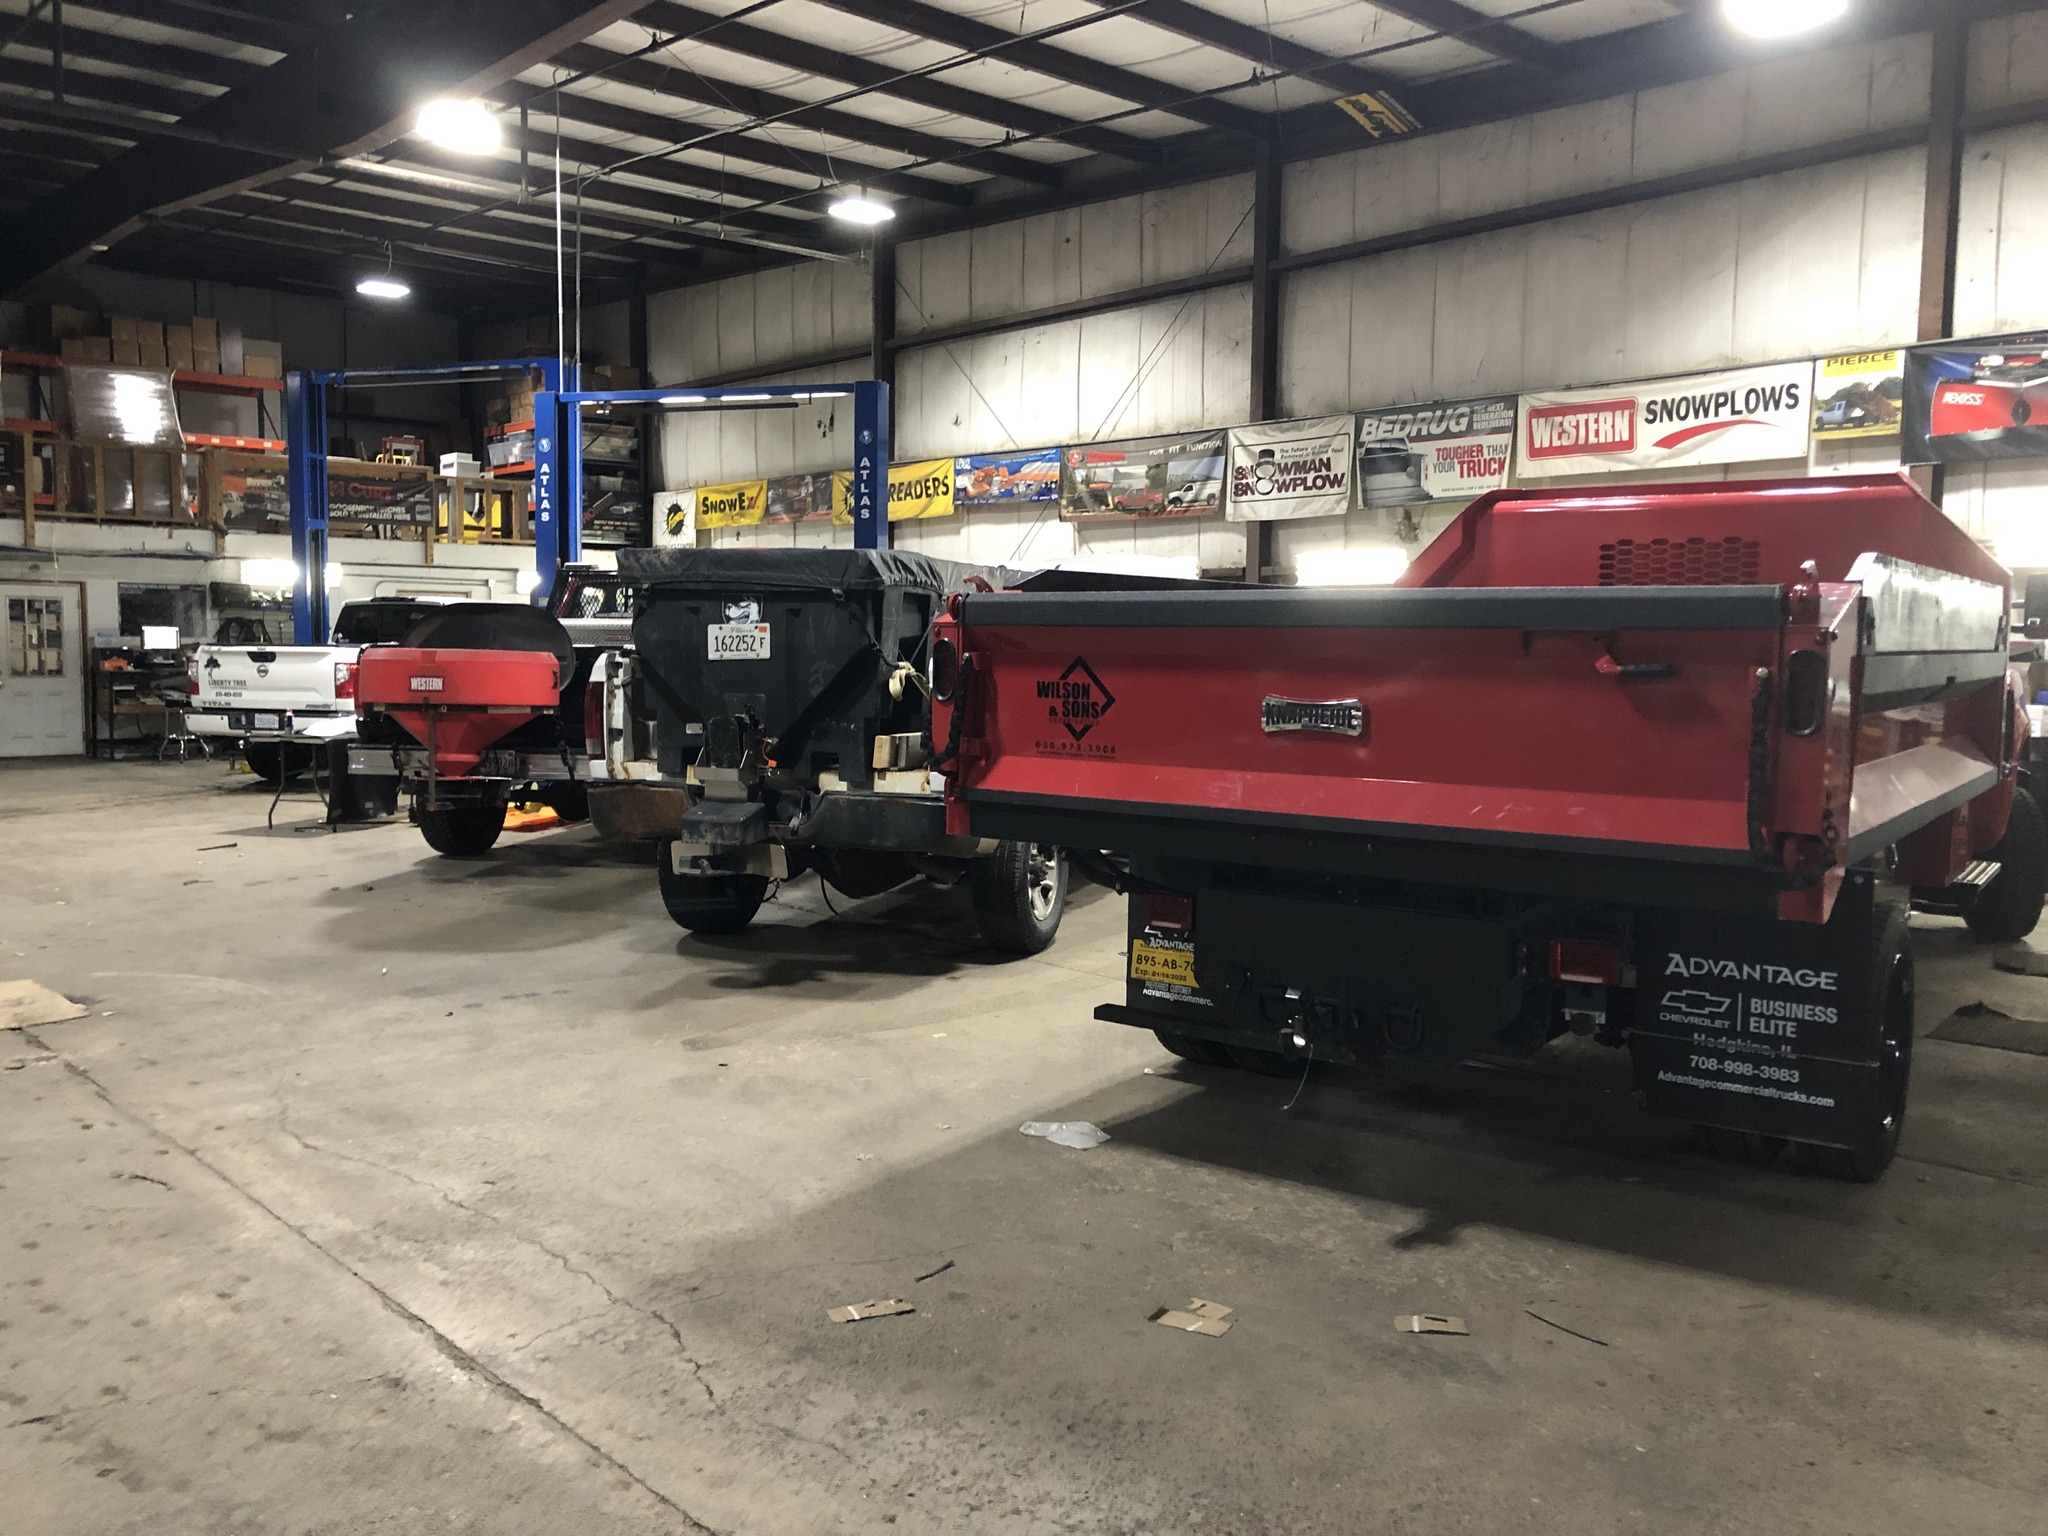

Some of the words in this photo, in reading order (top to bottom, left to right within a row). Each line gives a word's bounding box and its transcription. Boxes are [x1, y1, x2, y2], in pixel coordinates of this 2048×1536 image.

[1827, 353, 1895, 368] PIERCE
[1487, 403, 1505, 412] NEXT
[1644, 383, 1800, 424] SNOWPLOWS
[1942, 391, 1985, 406] BOSS
[1358, 406, 1471, 442] BEDRUG
[1473, 410, 1513, 422] GENERATION
[1532, 410, 1630, 448] WESTERN
[1168, 445, 1181, 454] FIT
[1186, 440, 1223, 452] FUNCTION
[1435, 443, 1484, 461] TOUGHER
[1486, 443, 1509, 457] THAN
[1432, 461, 1456, 474] YOUR
[1457, 456, 1507, 479] TRUCK
[540, 463, 550, 522] ATLAS
[860, 457, 870, 518] ATLAS
[888, 475, 949, 502] READERS
[714, 635, 756, 652] 162252
[760, 637, 766, 648] F
[208, 679, 231, 687] LIBERTY
[411, 677, 443, 690] WESTERN
[1037, 681, 1090, 700] WILSON
[1049, 705, 1058, 716] &
[1062, 700, 1099, 719] SONS
[1149, 937, 1195, 951] ADVANTAGE
[1664, 952, 1838, 990] ADVANTAGE
[1659, 1012, 1731, 1029] CHEVROLET
[1750, 998, 1838, 1024] BUSINESS
[1750, 1017, 1797, 1038] ELITE
[1689, 1055, 1800, 1083] 708-998-3983
[1657, 1070, 1835, 1107] Advantagecommercialtrucks.com
